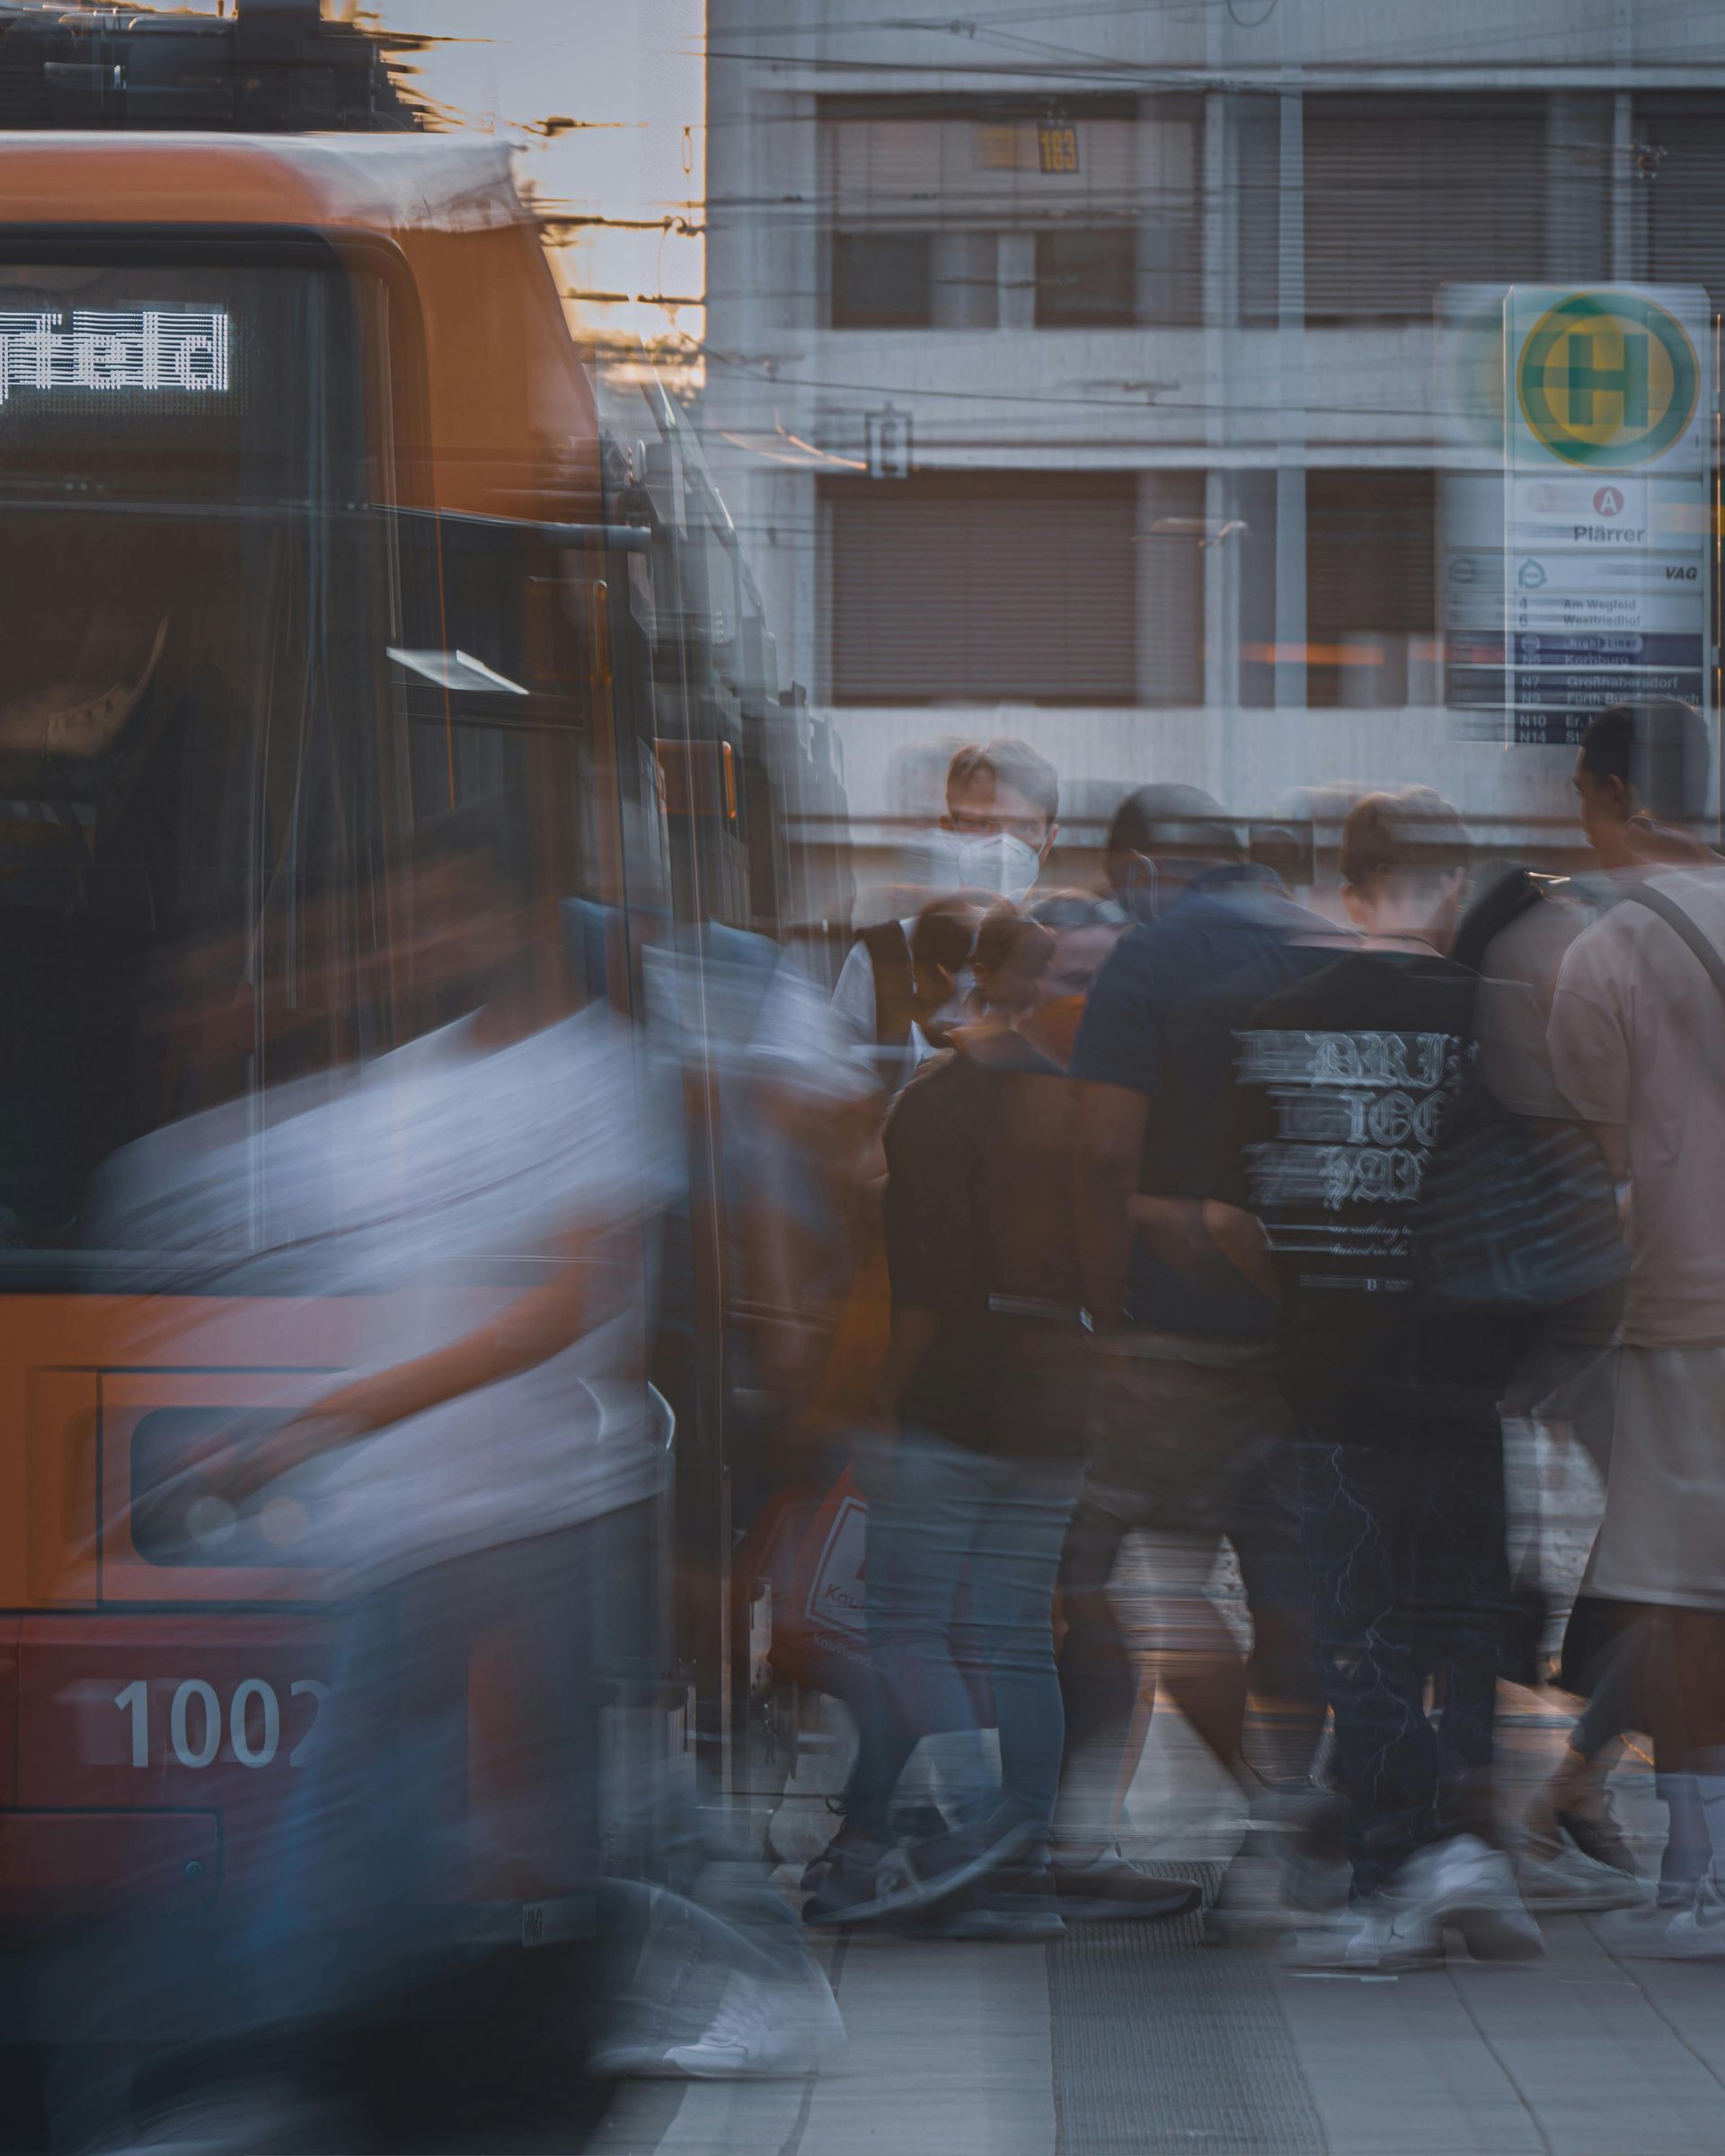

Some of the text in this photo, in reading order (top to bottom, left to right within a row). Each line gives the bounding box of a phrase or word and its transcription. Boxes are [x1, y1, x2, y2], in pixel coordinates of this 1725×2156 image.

[1040, 129, 1076, 171] 183
[1568, 333, 1650, 428] H
[1600, 490, 1618, 513] A
[1574, 525, 1645, 543] Plärrer
[1665, 566, 1699, 581] VAG
[1518, 596, 1637, 612] 4 Am Wegfeld
[1518, 614, 1641, 627] 6 Westfriedhof
[1521, 676, 1678, 689] N7 Großhabersdorf
[1567, 691, 1601, 704] Fürth
[1519, 715, 1547, 727] N10
[1520, 730, 1546, 743] N14
[114, 1678, 331, 1769] 1002
